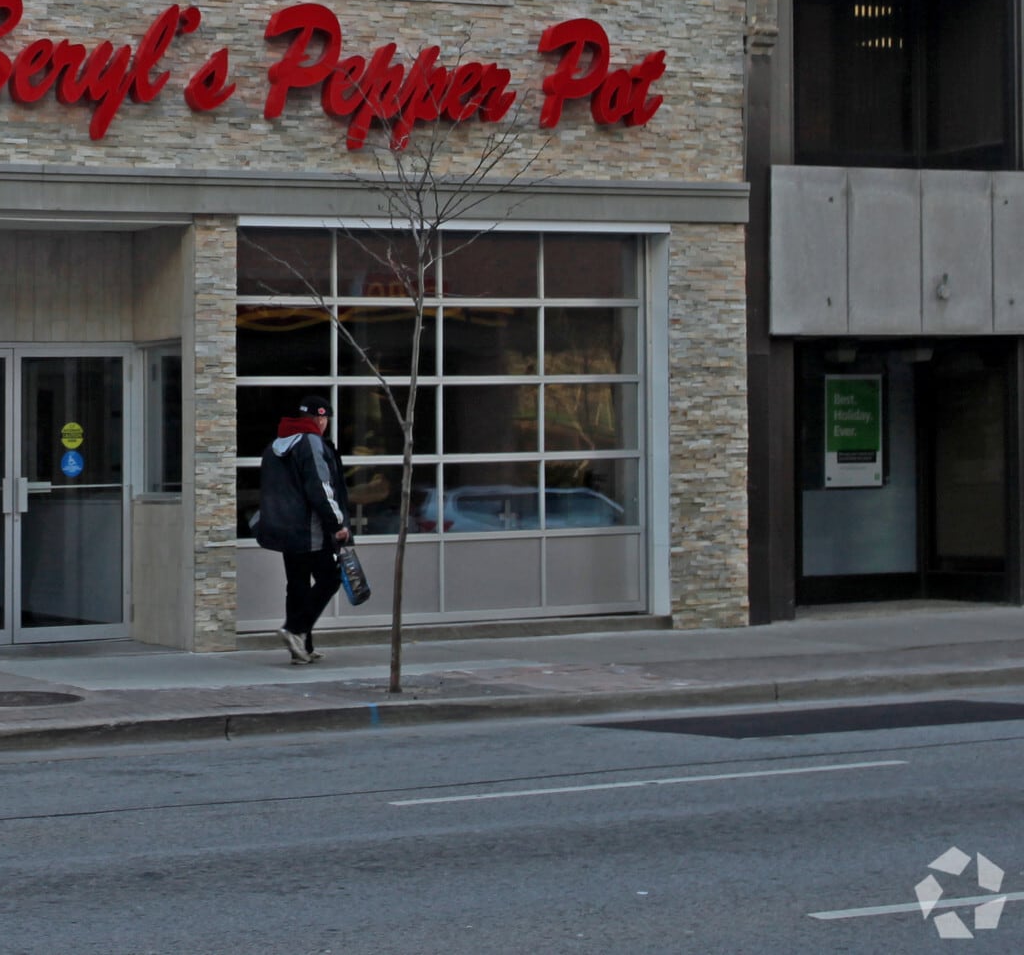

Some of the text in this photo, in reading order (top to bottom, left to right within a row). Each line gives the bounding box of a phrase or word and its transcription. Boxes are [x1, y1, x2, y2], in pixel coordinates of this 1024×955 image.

[264, 2, 517, 151] Pepper
[537, 17, 667, 130] Pot
[833, 425, 857, 437] Ever.
